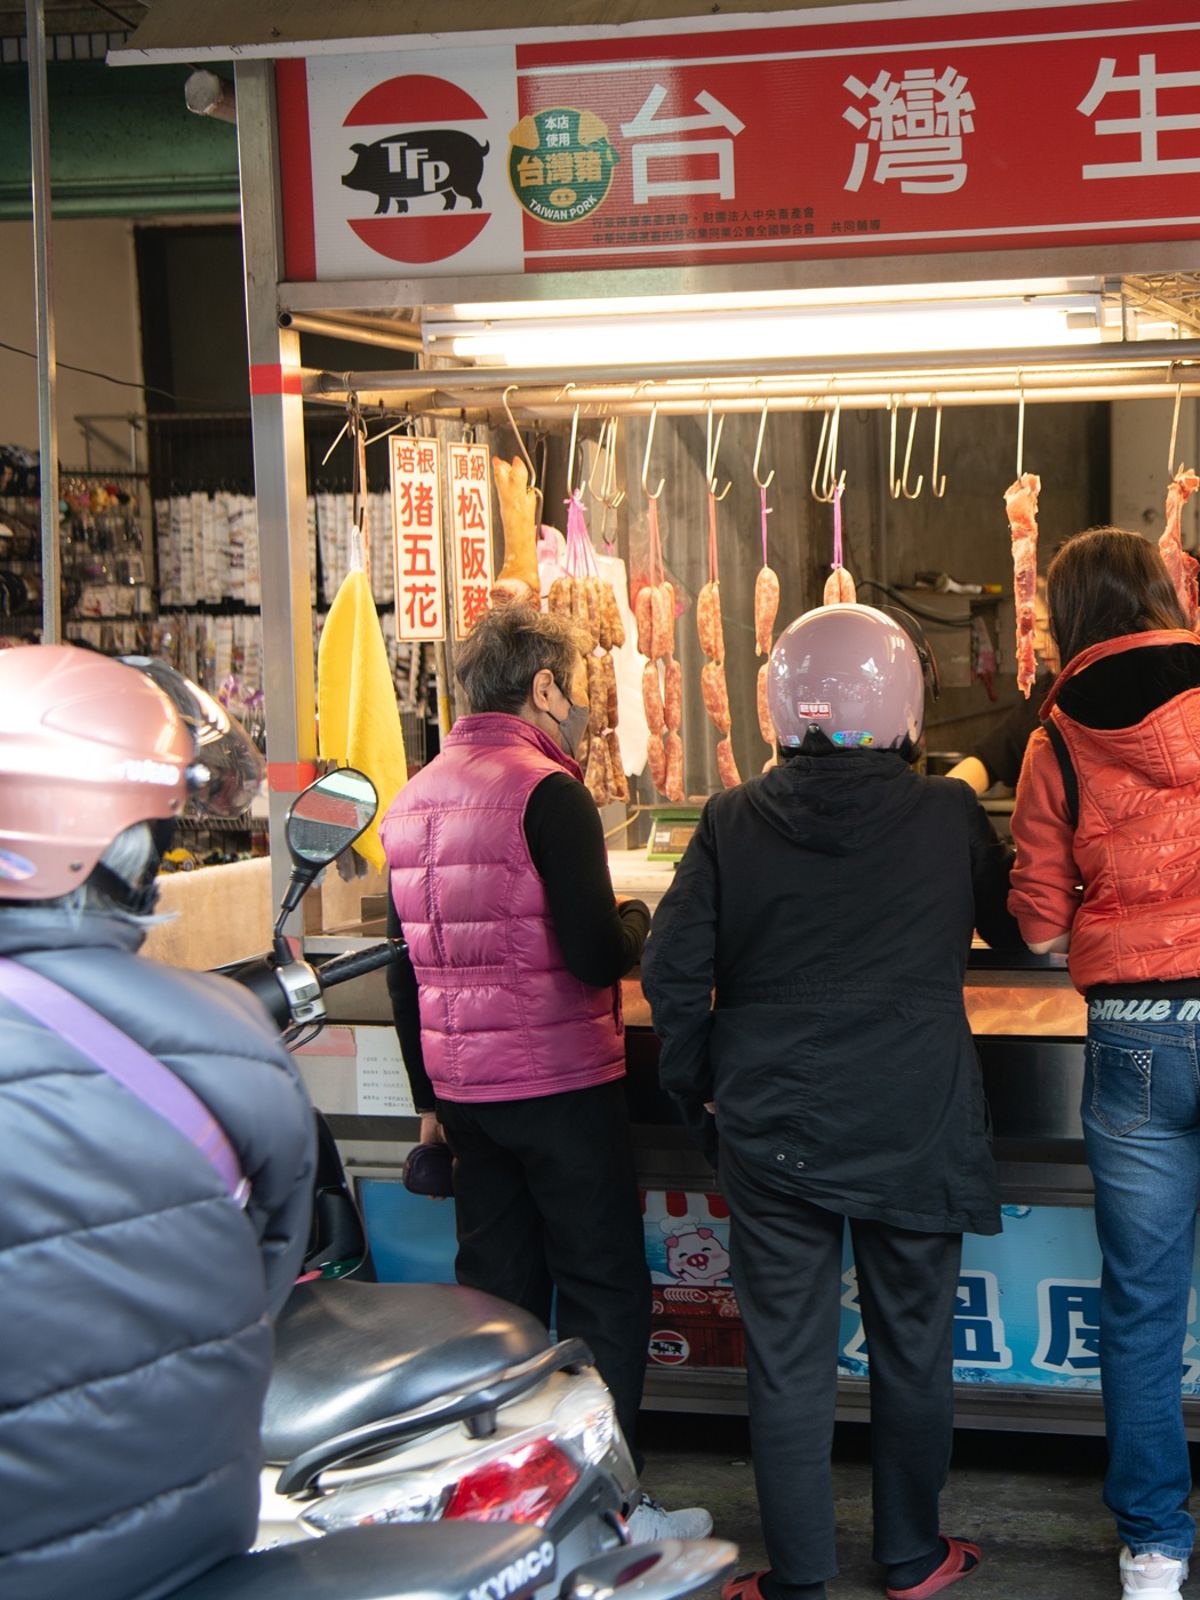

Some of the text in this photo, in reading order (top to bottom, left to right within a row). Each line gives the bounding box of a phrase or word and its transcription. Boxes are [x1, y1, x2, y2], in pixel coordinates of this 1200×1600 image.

[544, 115, 569, 130] 本店
[545, 132, 570, 148] 使用
[380, 141, 451, 192] TFP
[516, 150, 603, 188] 台灣豬
[528, 194, 598, 221] TAIWAN PORK
[396, 446, 435, 475] 培根
[453, 454, 486, 481] 頂級
